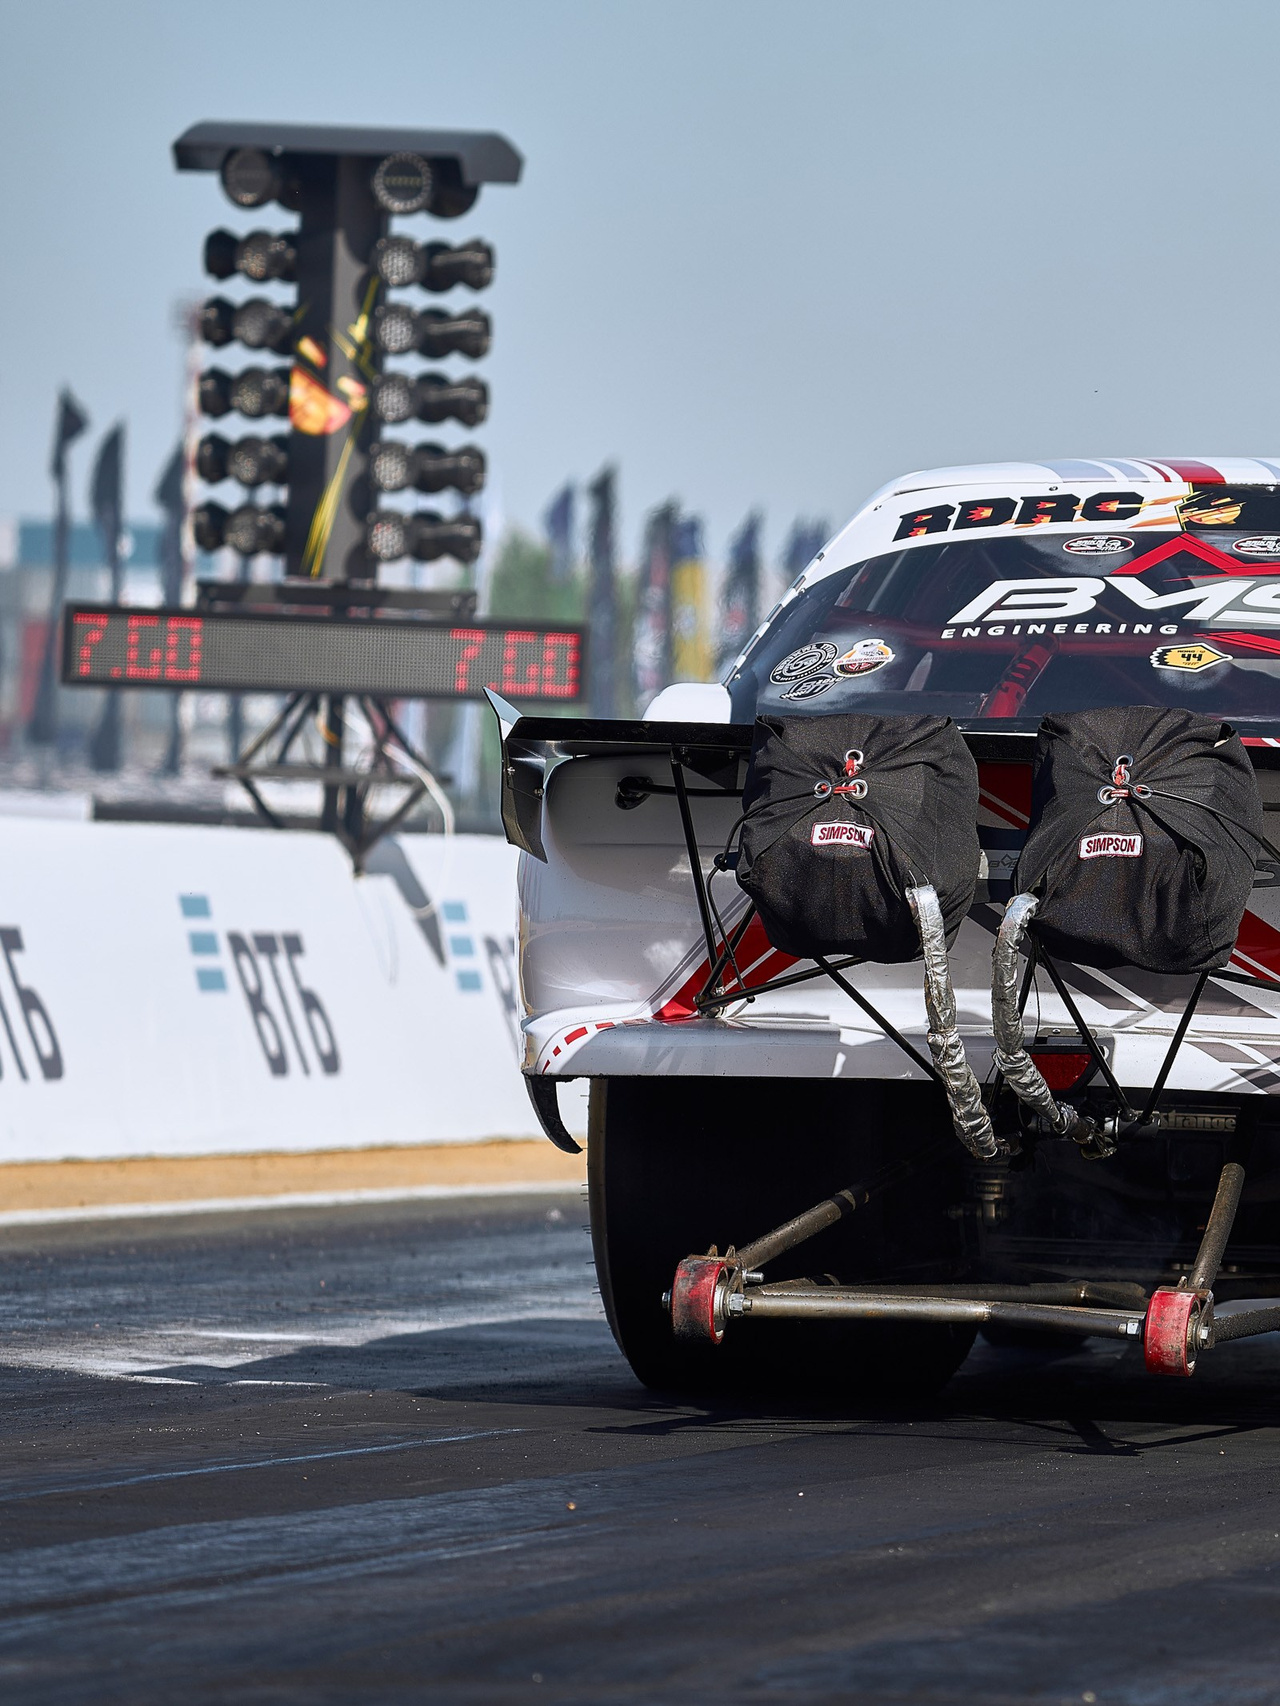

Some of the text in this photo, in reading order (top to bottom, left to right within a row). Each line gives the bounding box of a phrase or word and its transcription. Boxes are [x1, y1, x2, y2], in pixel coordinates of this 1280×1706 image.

[892, 492, 1144, 543] RDRC
[940, 622, 1180, 640] ENGINEERING
[1180, 653, 1203, 662] 44
[818, 826, 866, 844] SIMPSON
[1085, 837, 1136, 854] SIMPSON
[226, 932, 341, 1077] ВТБ
